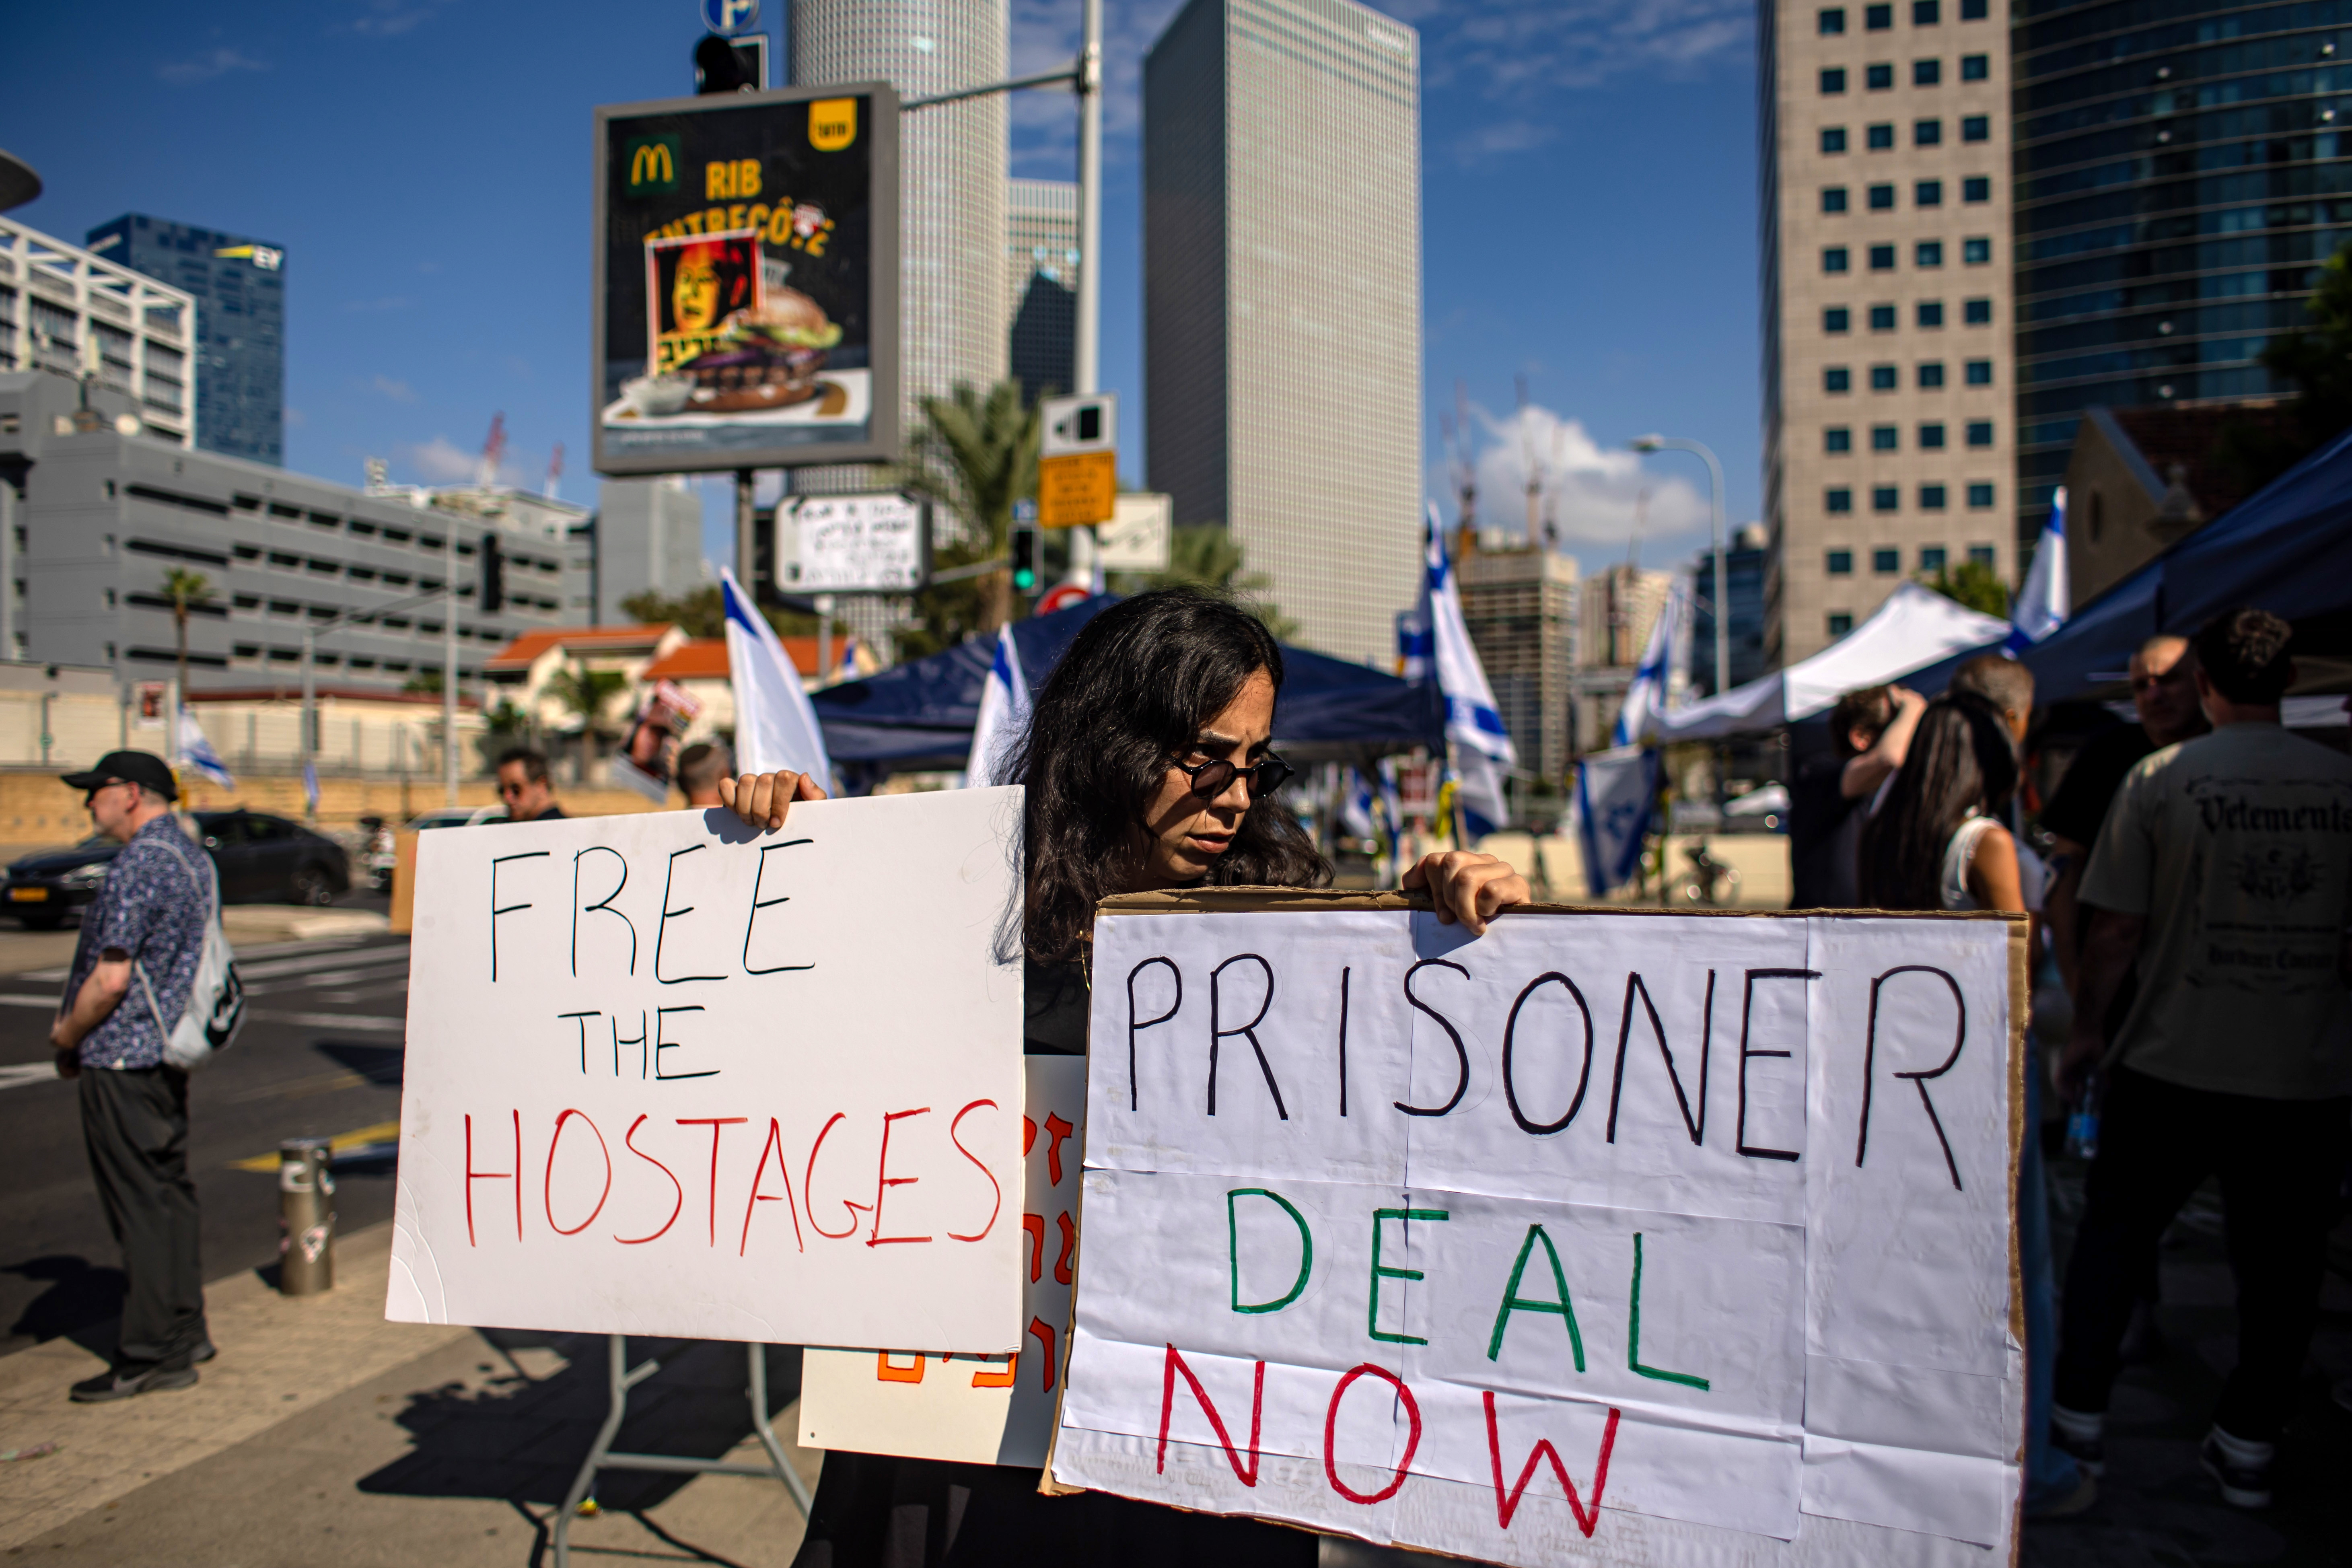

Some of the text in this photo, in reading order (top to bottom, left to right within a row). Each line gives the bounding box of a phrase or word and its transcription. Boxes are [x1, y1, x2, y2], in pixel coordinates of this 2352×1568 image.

[706, 158, 762, 200] RIB
[492, 839, 815, 984] FREE
[558, 1006, 721, 1080] THE
[1127, 953, 1966, 1191] PRISONER
[465, 1099, 1001, 1257] HOSTAGES
[1227, 1188, 1711, 1392] DEAL
[1155, 1342, 1621, 1539] NOW
